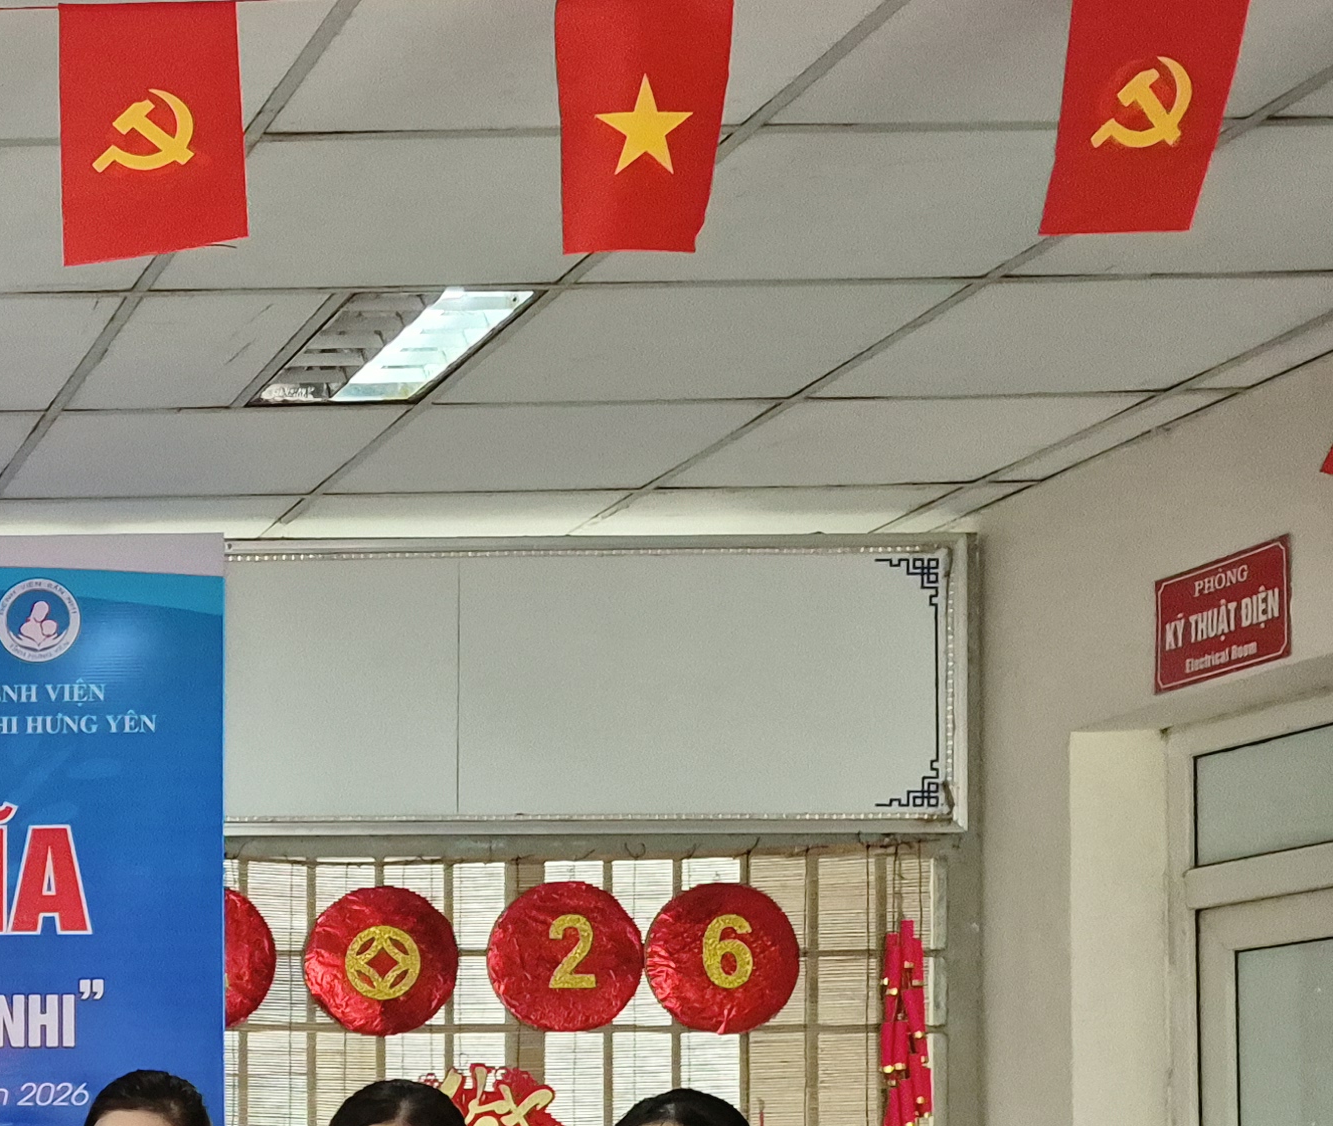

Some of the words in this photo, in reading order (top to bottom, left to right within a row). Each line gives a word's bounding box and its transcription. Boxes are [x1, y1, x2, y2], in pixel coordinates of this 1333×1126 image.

[1193, 565, 1249, 598] PHÒNG
[1188, 598, 1238, 643] THUẬT
[1240, 585, 1280, 629] ĐIỆN
[1184, 648, 1231, 674] Electrical
[44, 677, 107, 707] VIỆN
[25, 711, 98, 735] HƯNG
[106, 709, 157, 734] YÊN
[15, 1082, 90, 1108] 2026
